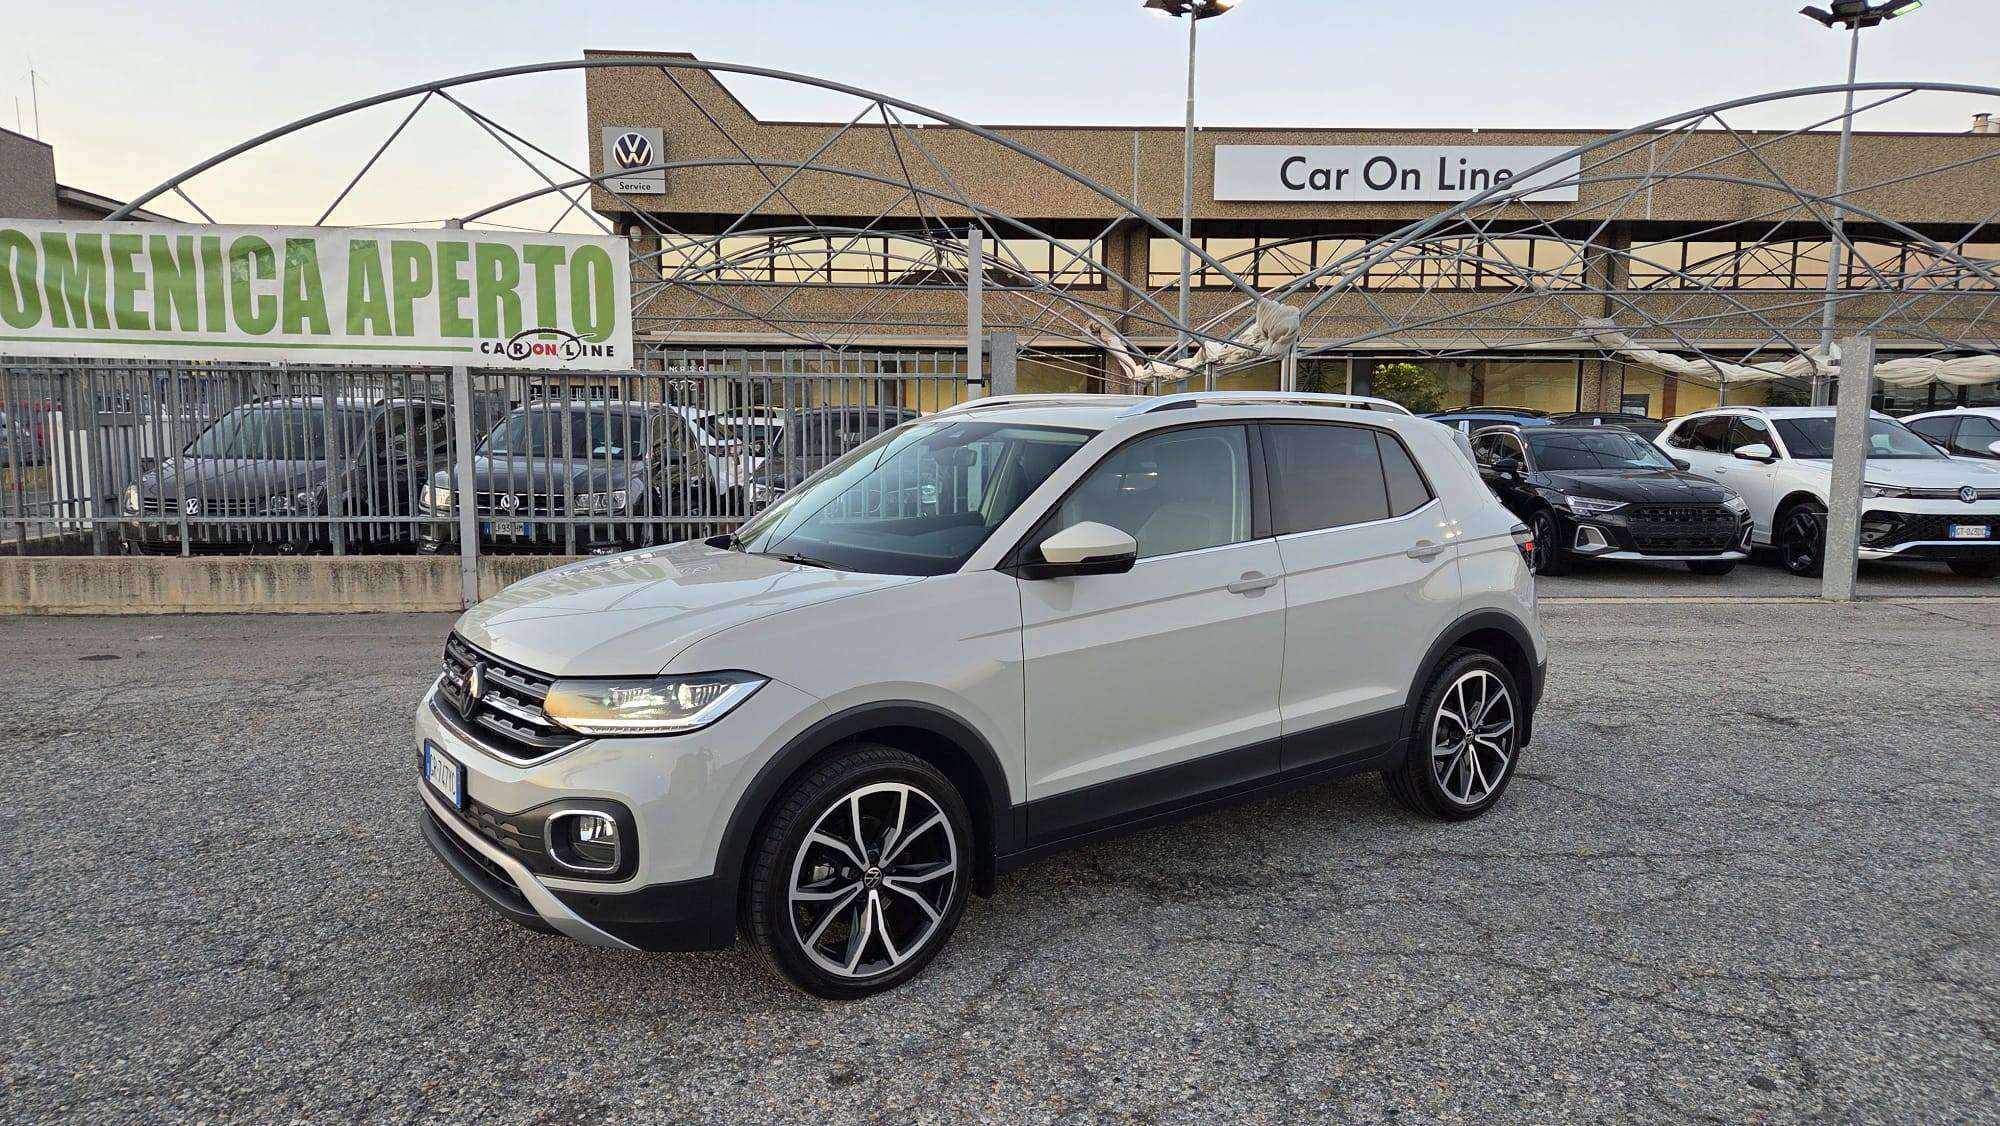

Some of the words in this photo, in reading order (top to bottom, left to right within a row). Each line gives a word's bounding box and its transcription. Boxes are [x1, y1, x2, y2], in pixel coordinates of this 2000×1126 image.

[619, 181, 651, 190] Service
[1280, 156, 1348, 190] Car
[1363, 156, 1421, 190] On
[1438, 156, 1514, 190] Line
[345, 239, 616, 343] APERTO
